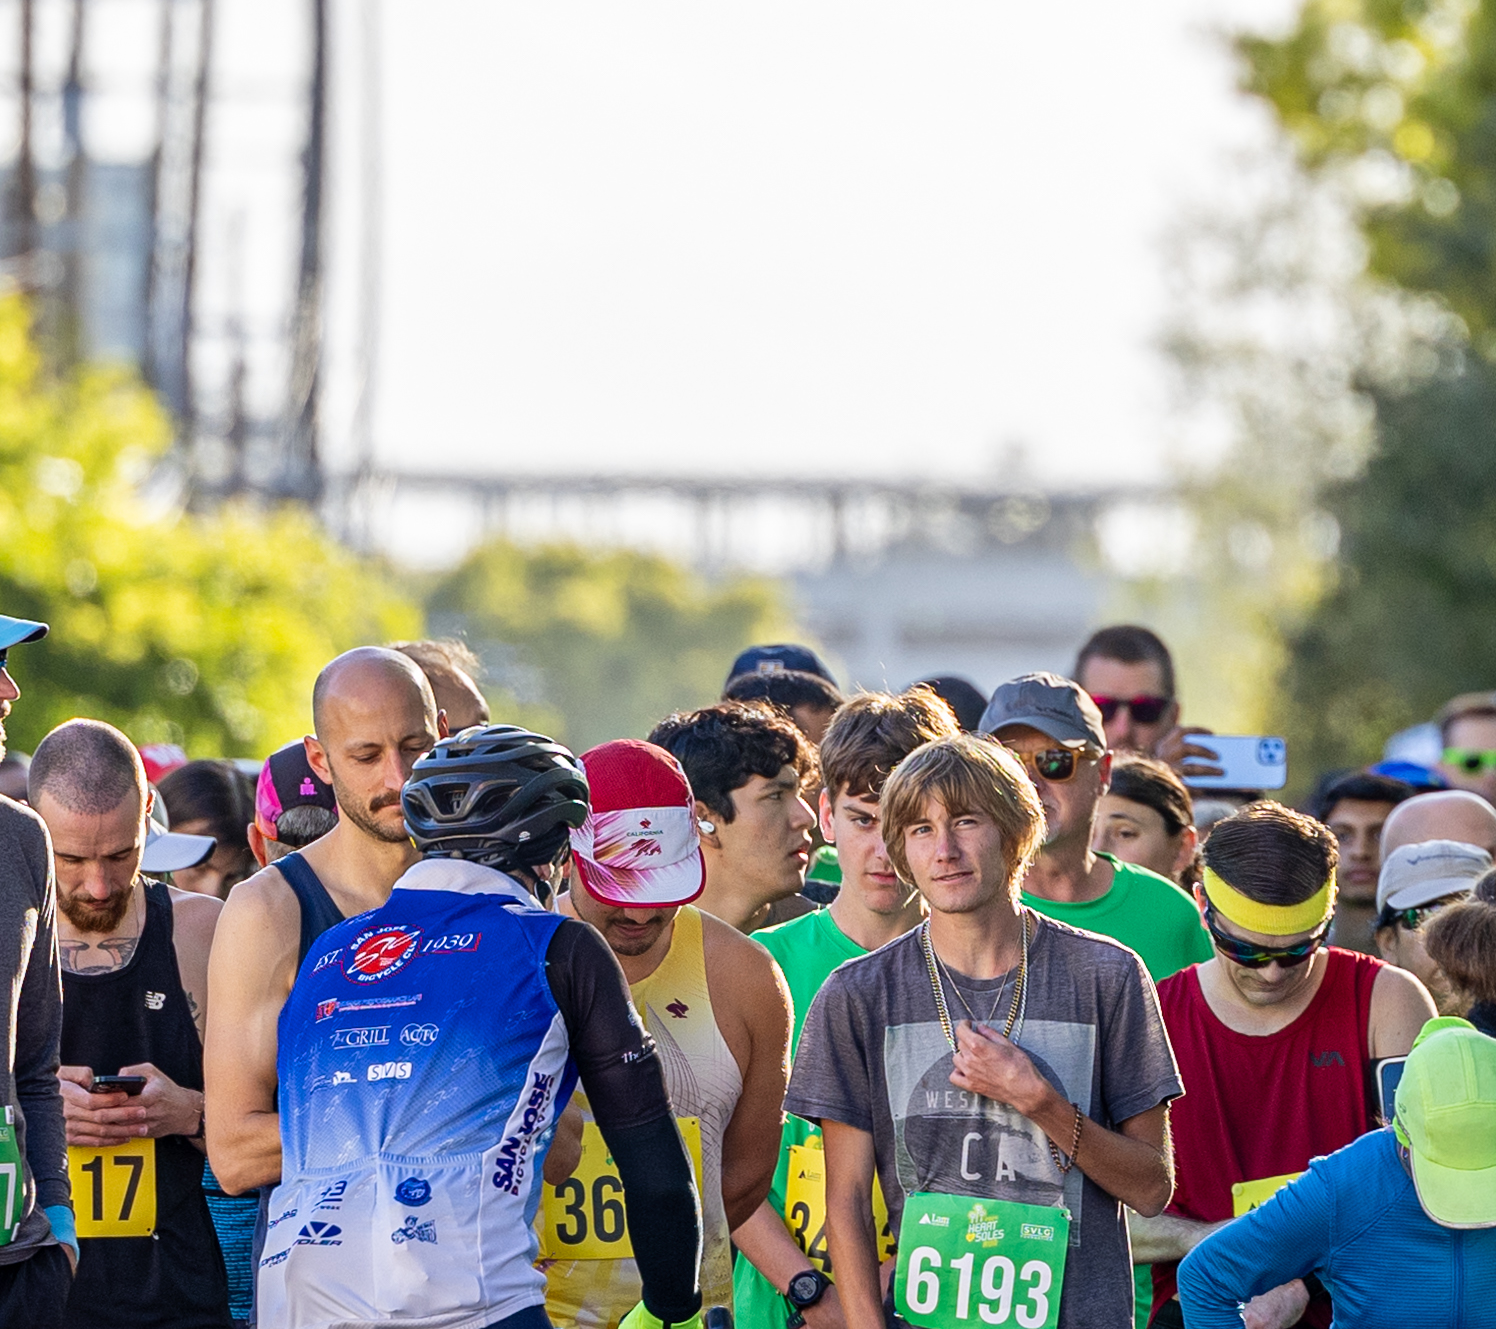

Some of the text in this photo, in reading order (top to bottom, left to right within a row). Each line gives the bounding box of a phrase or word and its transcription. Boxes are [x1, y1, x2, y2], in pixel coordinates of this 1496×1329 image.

[357, 960, 403, 982] BICYCLE
[346, 1029, 390, 1045] GRILL
[81, 1156, 144, 1221] 17
[492, 1137, 521, 1192] SAN
[555, 1175, 625, 1245] 36
[791, 1201, 832, 1273] 34
[906, 1246, 1052, 1329] 6193
